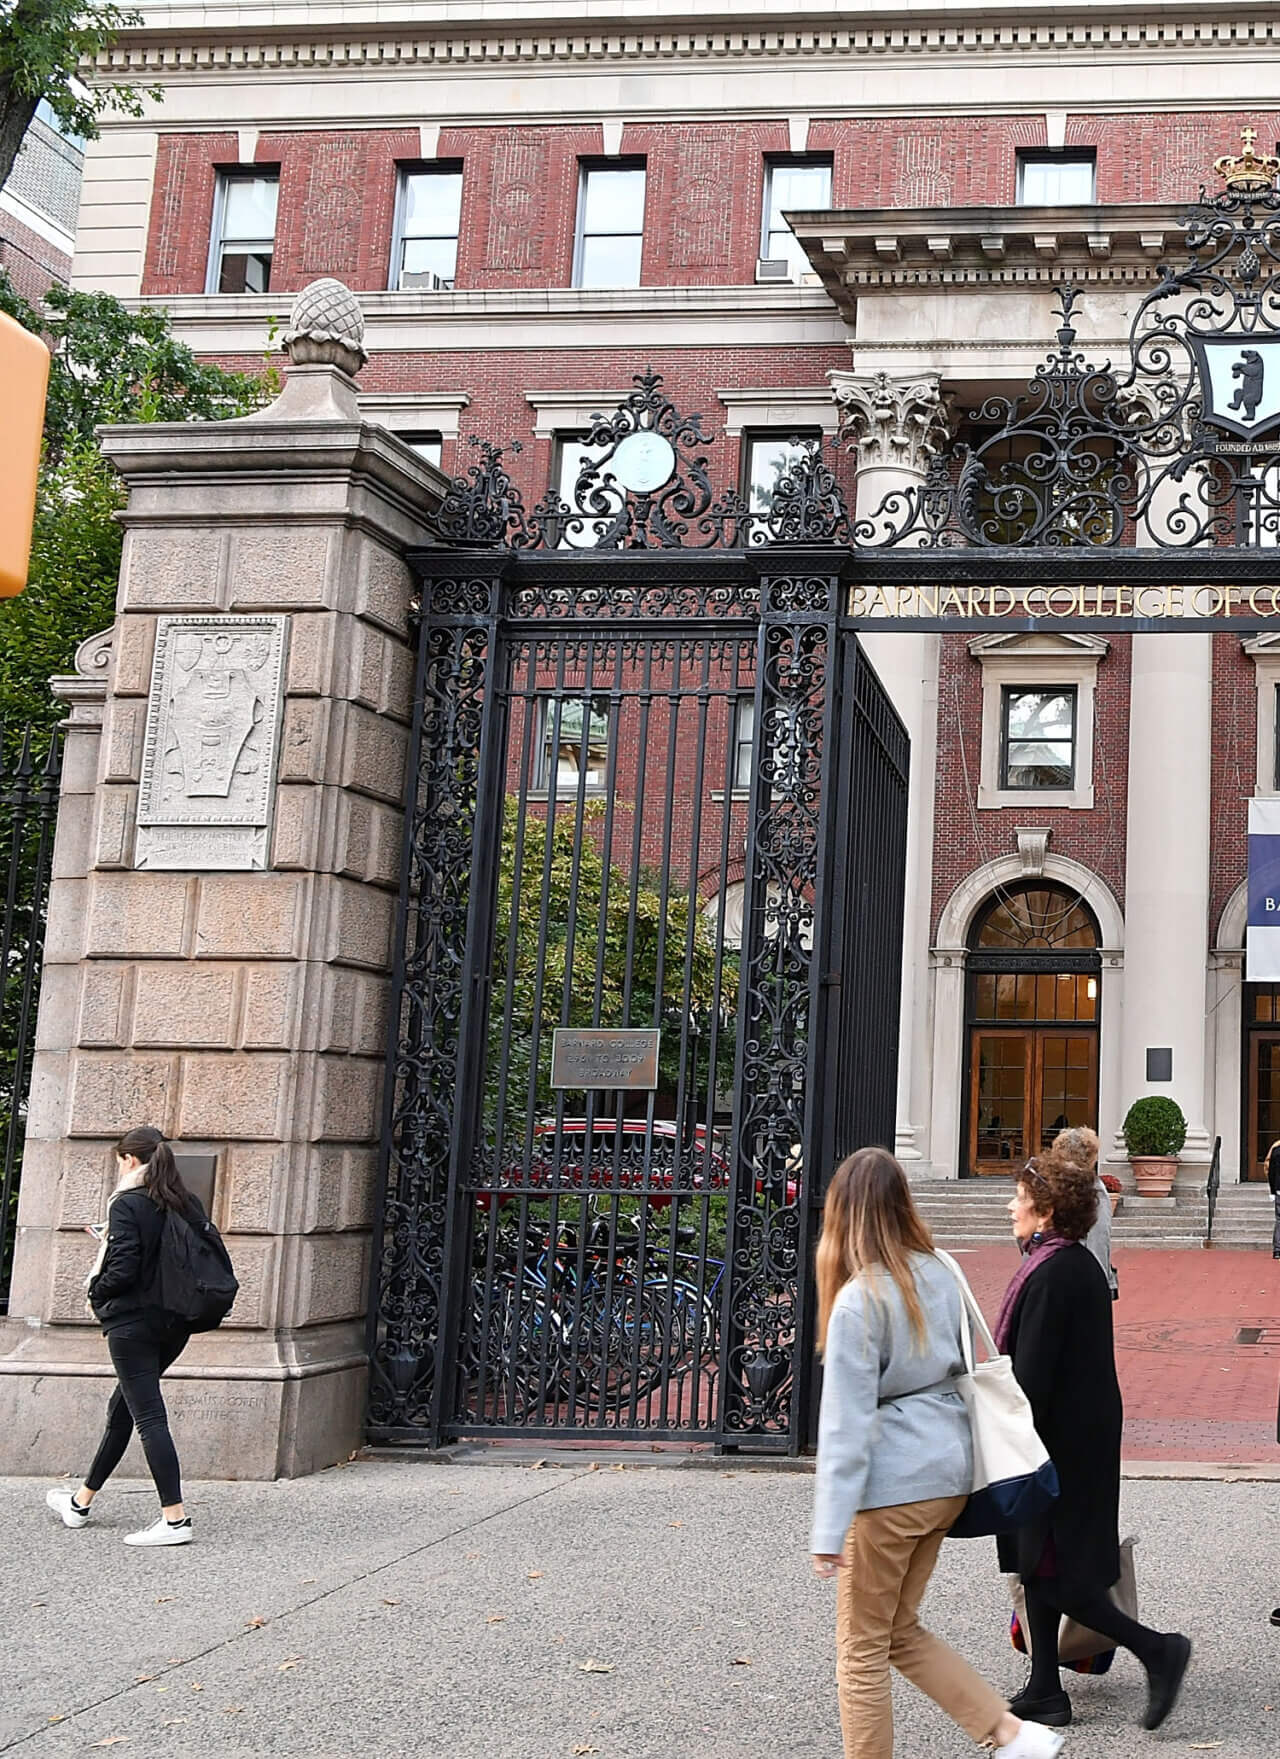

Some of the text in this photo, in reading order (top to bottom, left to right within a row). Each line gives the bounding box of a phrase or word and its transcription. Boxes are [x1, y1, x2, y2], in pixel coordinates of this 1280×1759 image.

[847, 585, 1015, 618] BARNARD
[1021, 585, 1184, 618] COLLEGE
[1191, 585, 1242, 618] OF
[560, 1039, 655, 1049] BARNARD COLLEGE
